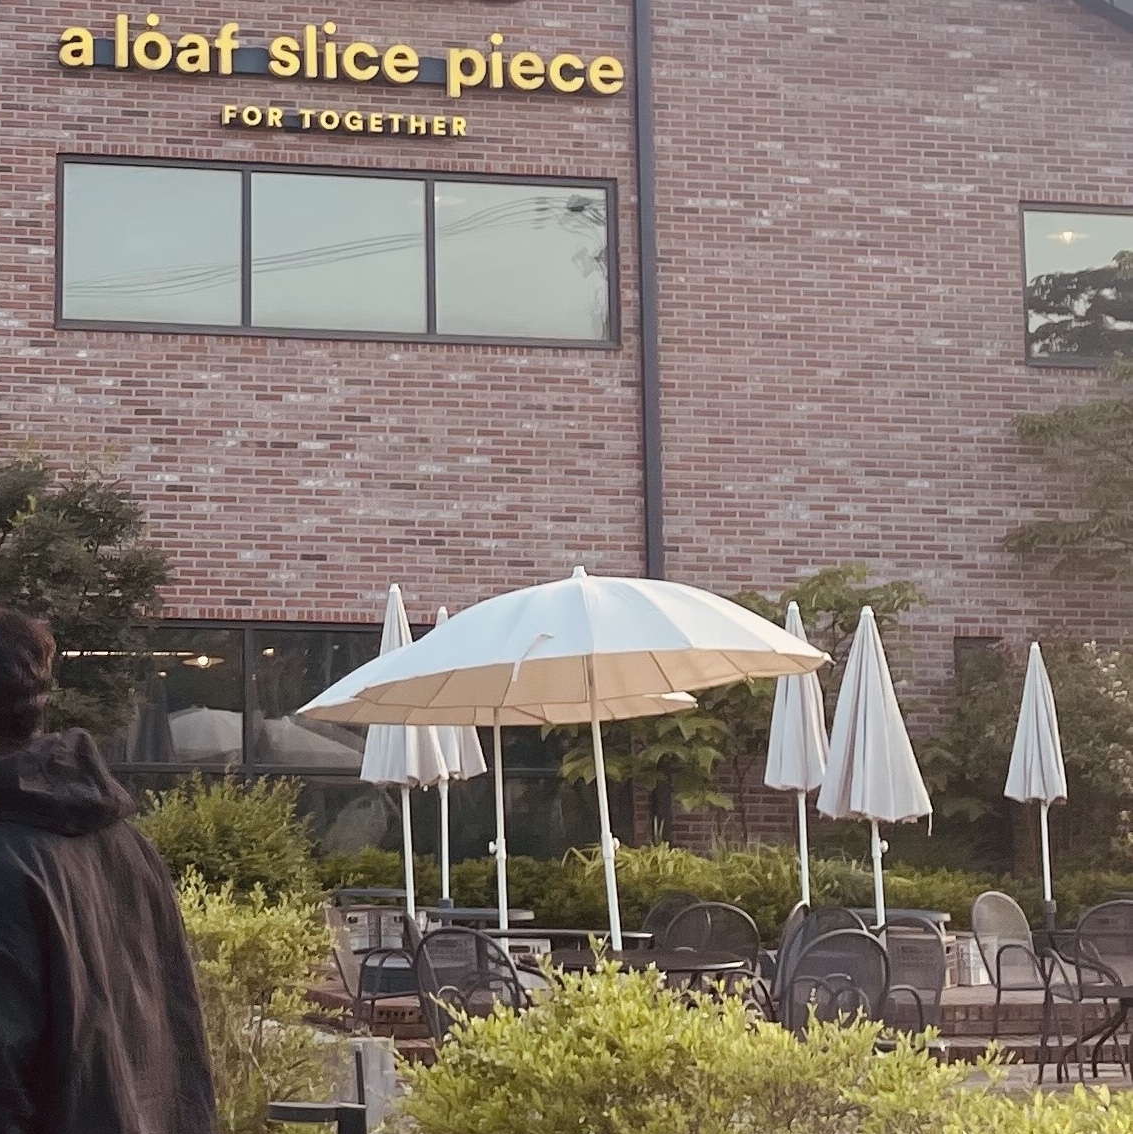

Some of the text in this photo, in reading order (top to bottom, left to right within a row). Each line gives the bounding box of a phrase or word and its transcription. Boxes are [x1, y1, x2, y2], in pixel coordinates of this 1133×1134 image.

[59, 13, 625, 98] a loaf slice piece
[223, 104, 468, 136] FOR TOGETHER
